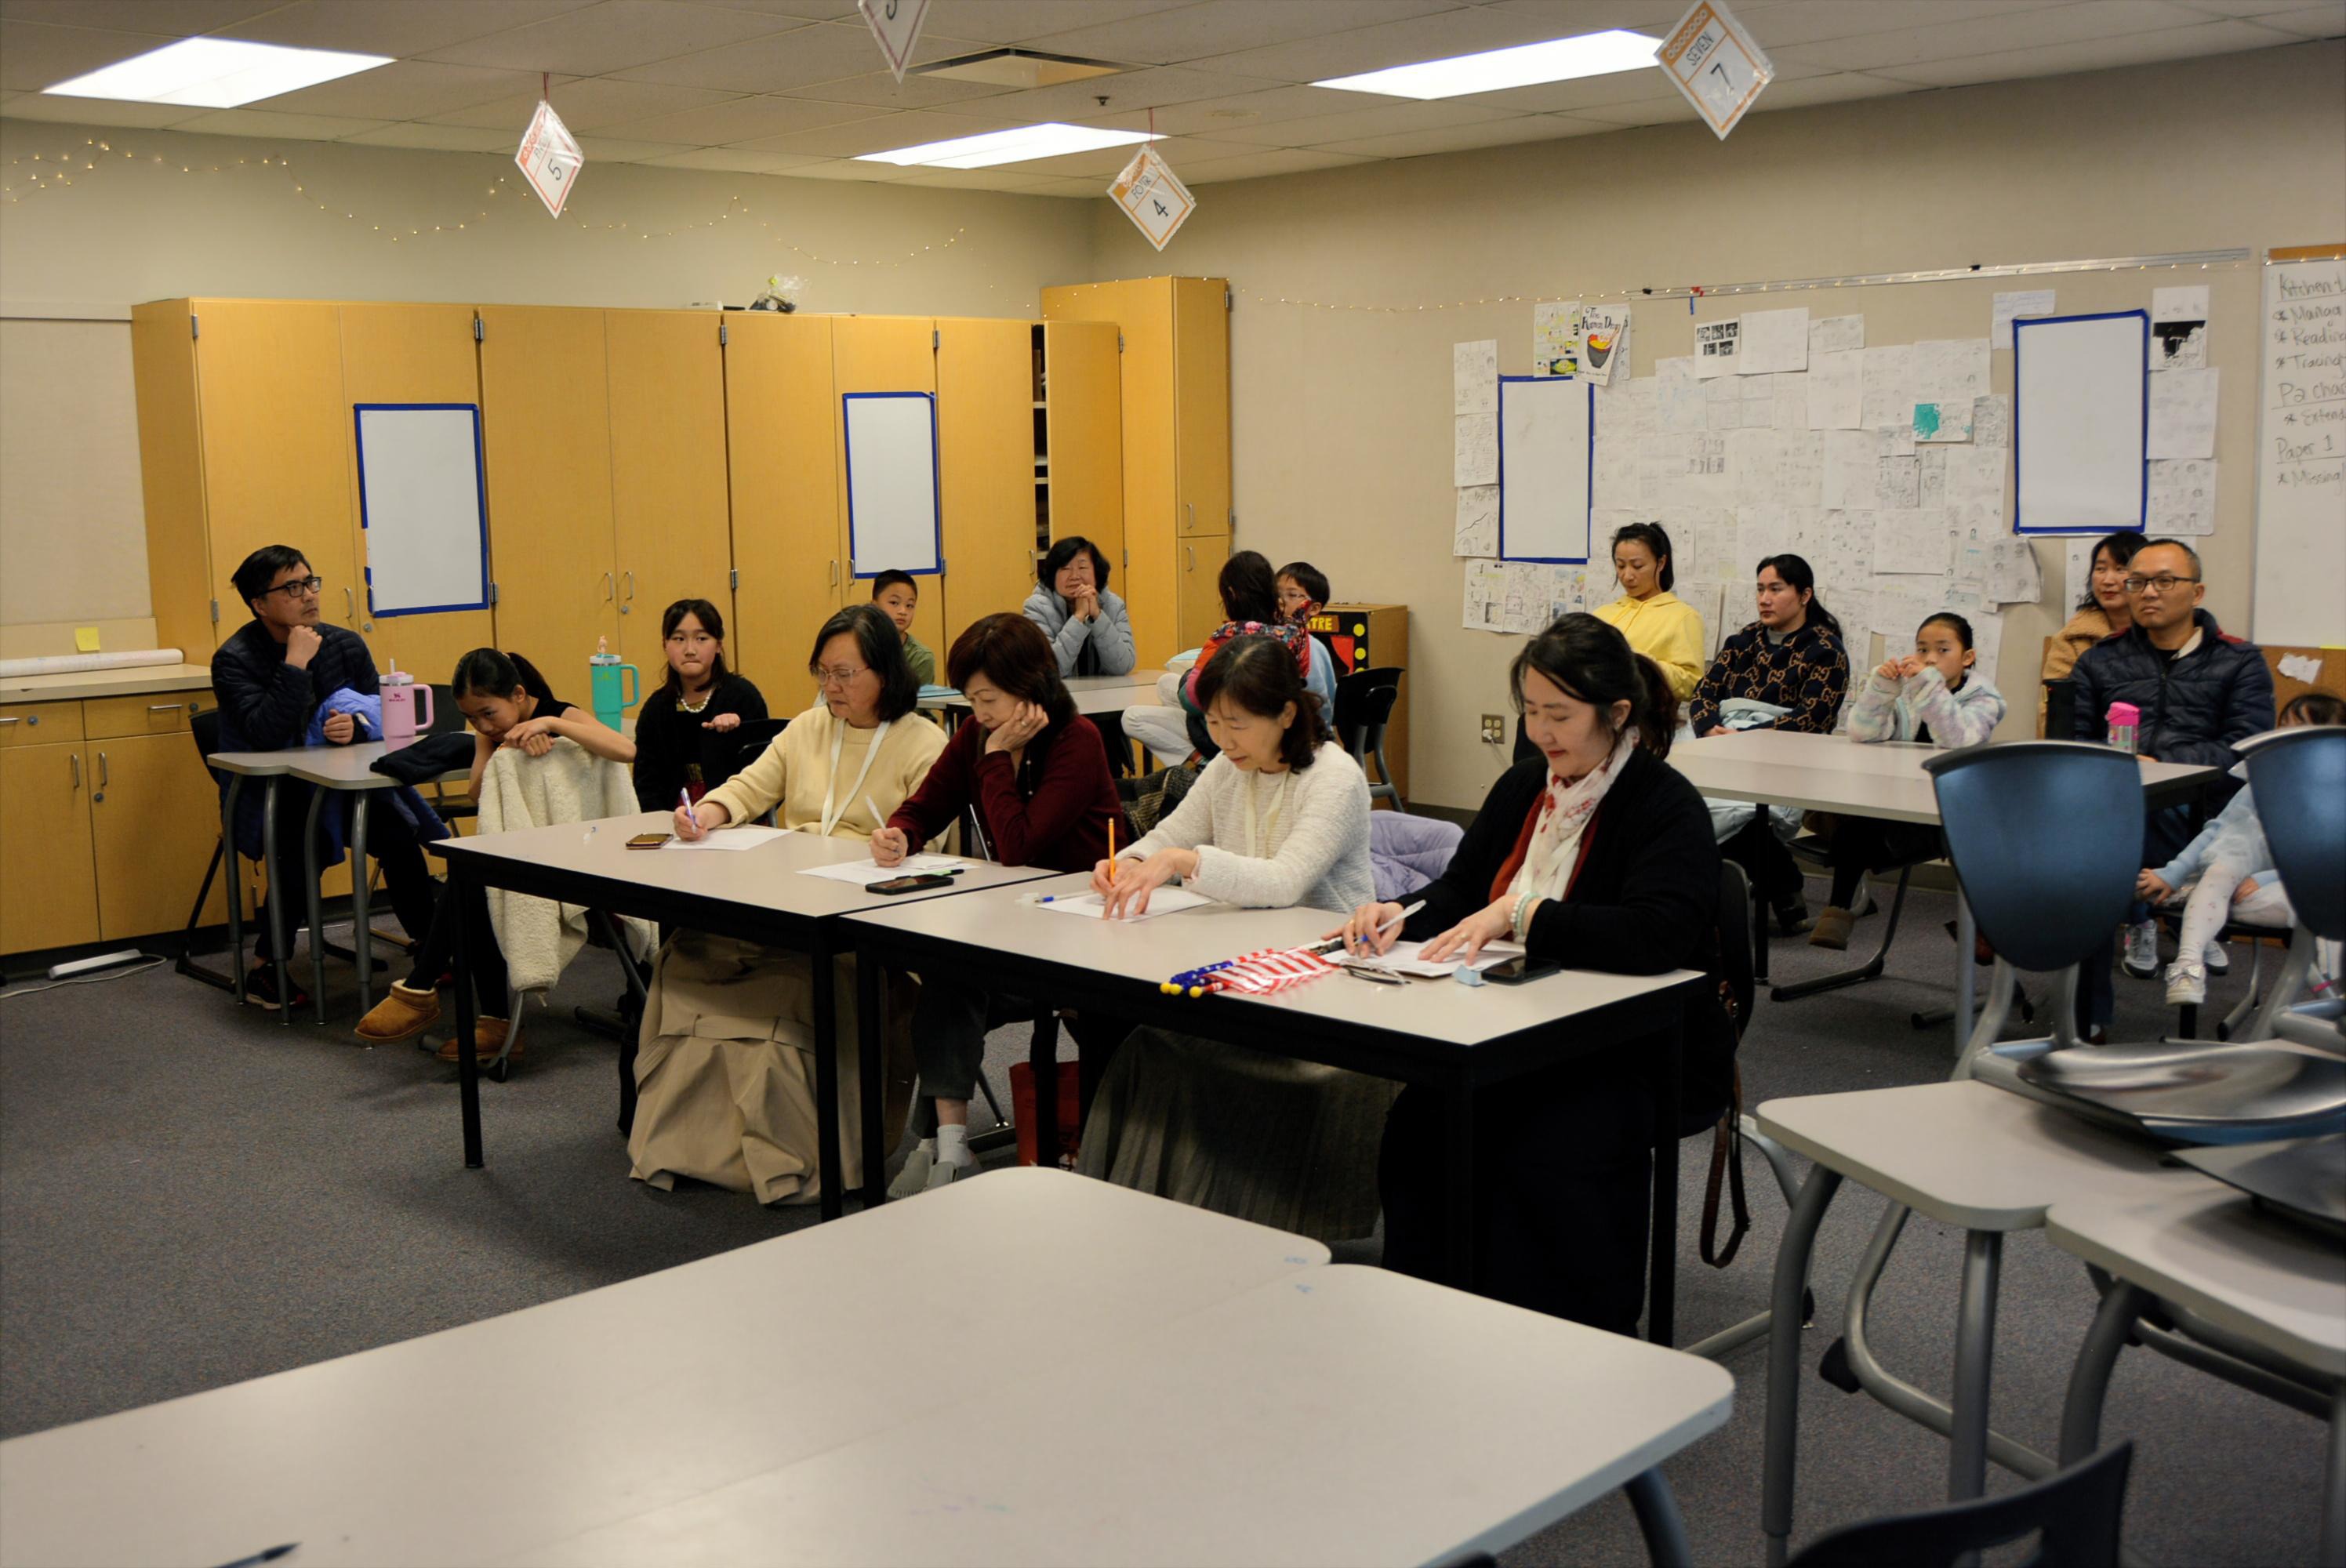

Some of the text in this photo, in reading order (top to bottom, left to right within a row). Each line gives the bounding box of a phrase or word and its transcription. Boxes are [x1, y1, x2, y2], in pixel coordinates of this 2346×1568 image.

[1687, 31, 1714, 66] SEVEN
[1710, 63, 1734, 93] 7
[548, 158, 562, 180] 5
[1131, 175, 1151, 200] FOUR
[1153, 199, 1168, 216] 4
[2275, 437, 2315, 466] Paper
[1306, 616, 1332, 630] TRE
